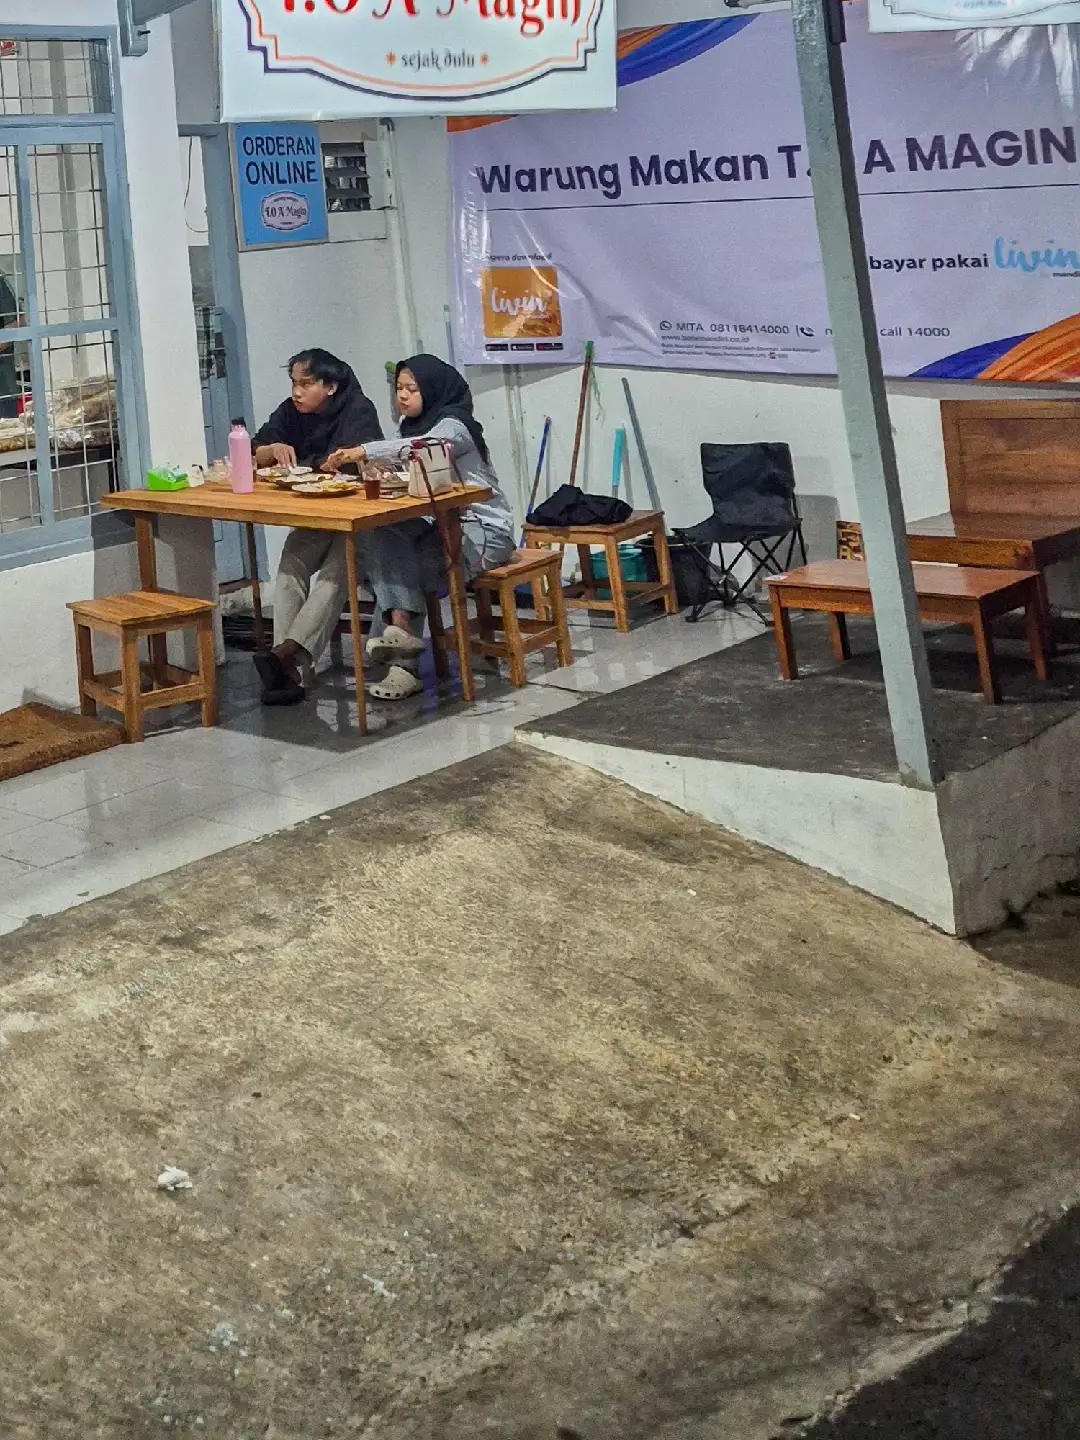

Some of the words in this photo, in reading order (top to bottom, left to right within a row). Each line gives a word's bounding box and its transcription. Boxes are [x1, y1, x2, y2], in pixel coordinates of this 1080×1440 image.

[401, 48, 441, 72] sejak
[444, 48, 475, 68] dulu
[242, 136, 316, 157] ORDERAN
[245, 160, 318, 185] ONLINE
[476, 162, 621, 200] Warung
[629, 150, 769, 187] Makan
[863, 139, 896, 175] A
[905, 126, 1077, 172] MAGIN
[869, 256, 926, 273] bayar
[931, 253, 990, 271] pakai
[676, 322, 705, 332] MITA
[879, 327, 902, 337] call
[907, 327, 951, 337] 14000
